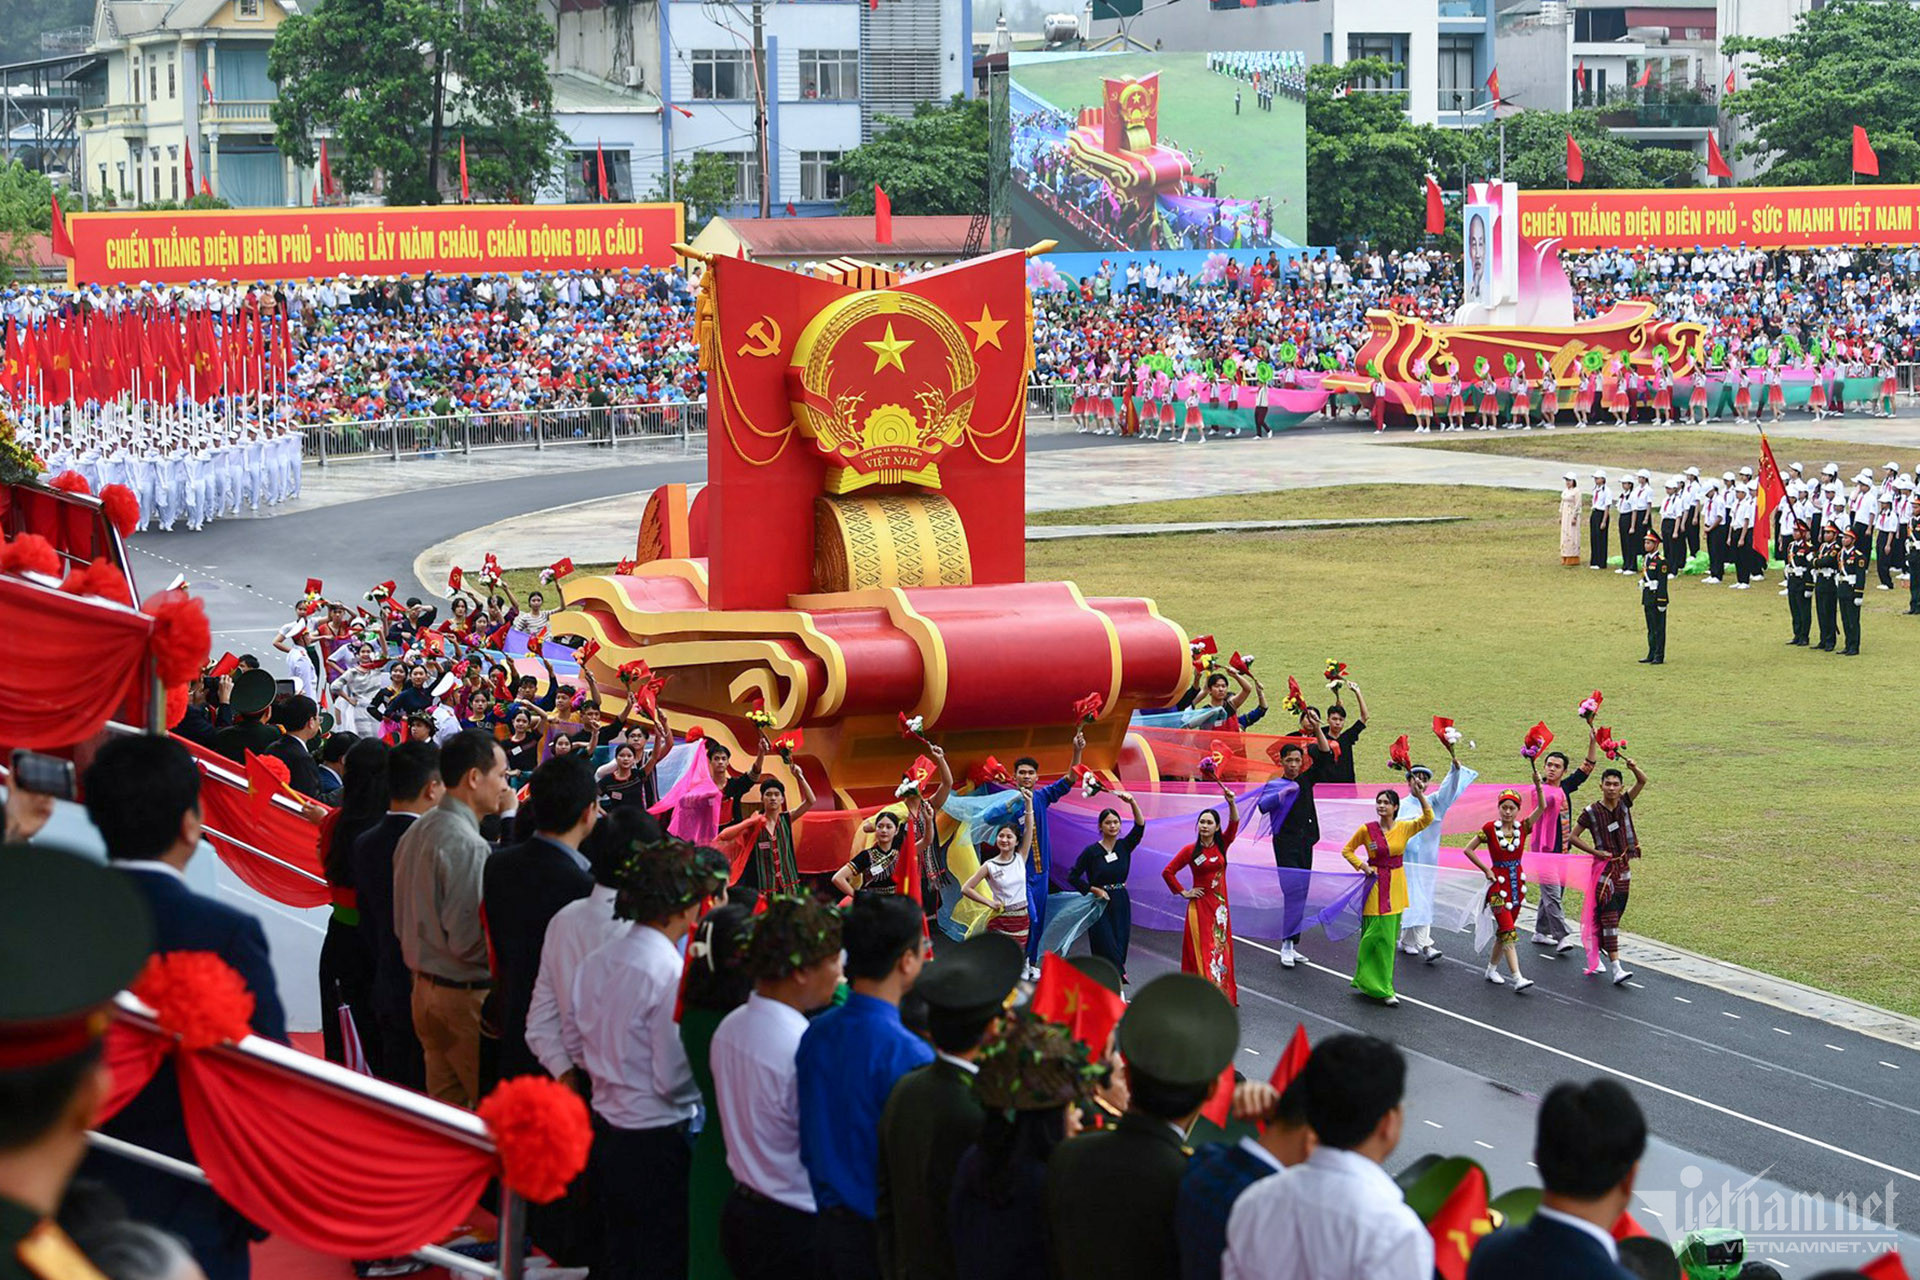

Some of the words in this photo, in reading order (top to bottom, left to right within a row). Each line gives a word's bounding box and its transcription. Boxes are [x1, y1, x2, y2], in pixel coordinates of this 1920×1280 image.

[1521, 203, 1568, 237] CHIẾN
[1571, 202, 1621, 237] THẮNG
[1625, 205, 1661, 241] ĐIỆN
[1665, 205, 1701, 235] BIÊN
[1705, 201, 1737, 235] PHỦ
[1752, 203, 1783, 234] SỨC
[1787, 207, 1834, 238] MẠNH
[1838, 201, 1871, 237] VIỆT
[1875, 205, 1912, 231] NAM
[106, 228, 150, 270] CHIẾN
[152, 225, 201, 268] THẮNG
[203, 229, 240, 272] ĐIỆN
[243, 228, 278, 265] BIÊN
[281, 224, 312, 263] PHỦ
[325, 227, 365, 262] LỪNG
[368, 221, 395, 261] LẪY
[400, 225, 435, 260] NĂM
[438, 224, 483, 261] CHÂU,
[486, 219, 527, 258] CHẤN
[530, 223, 572, 263] ĐỘNG
[575, 228, 602, 262] ĐỊA
[865, 455, 890, 468] VIỆT
[893, 455, 918, 467] NAM
